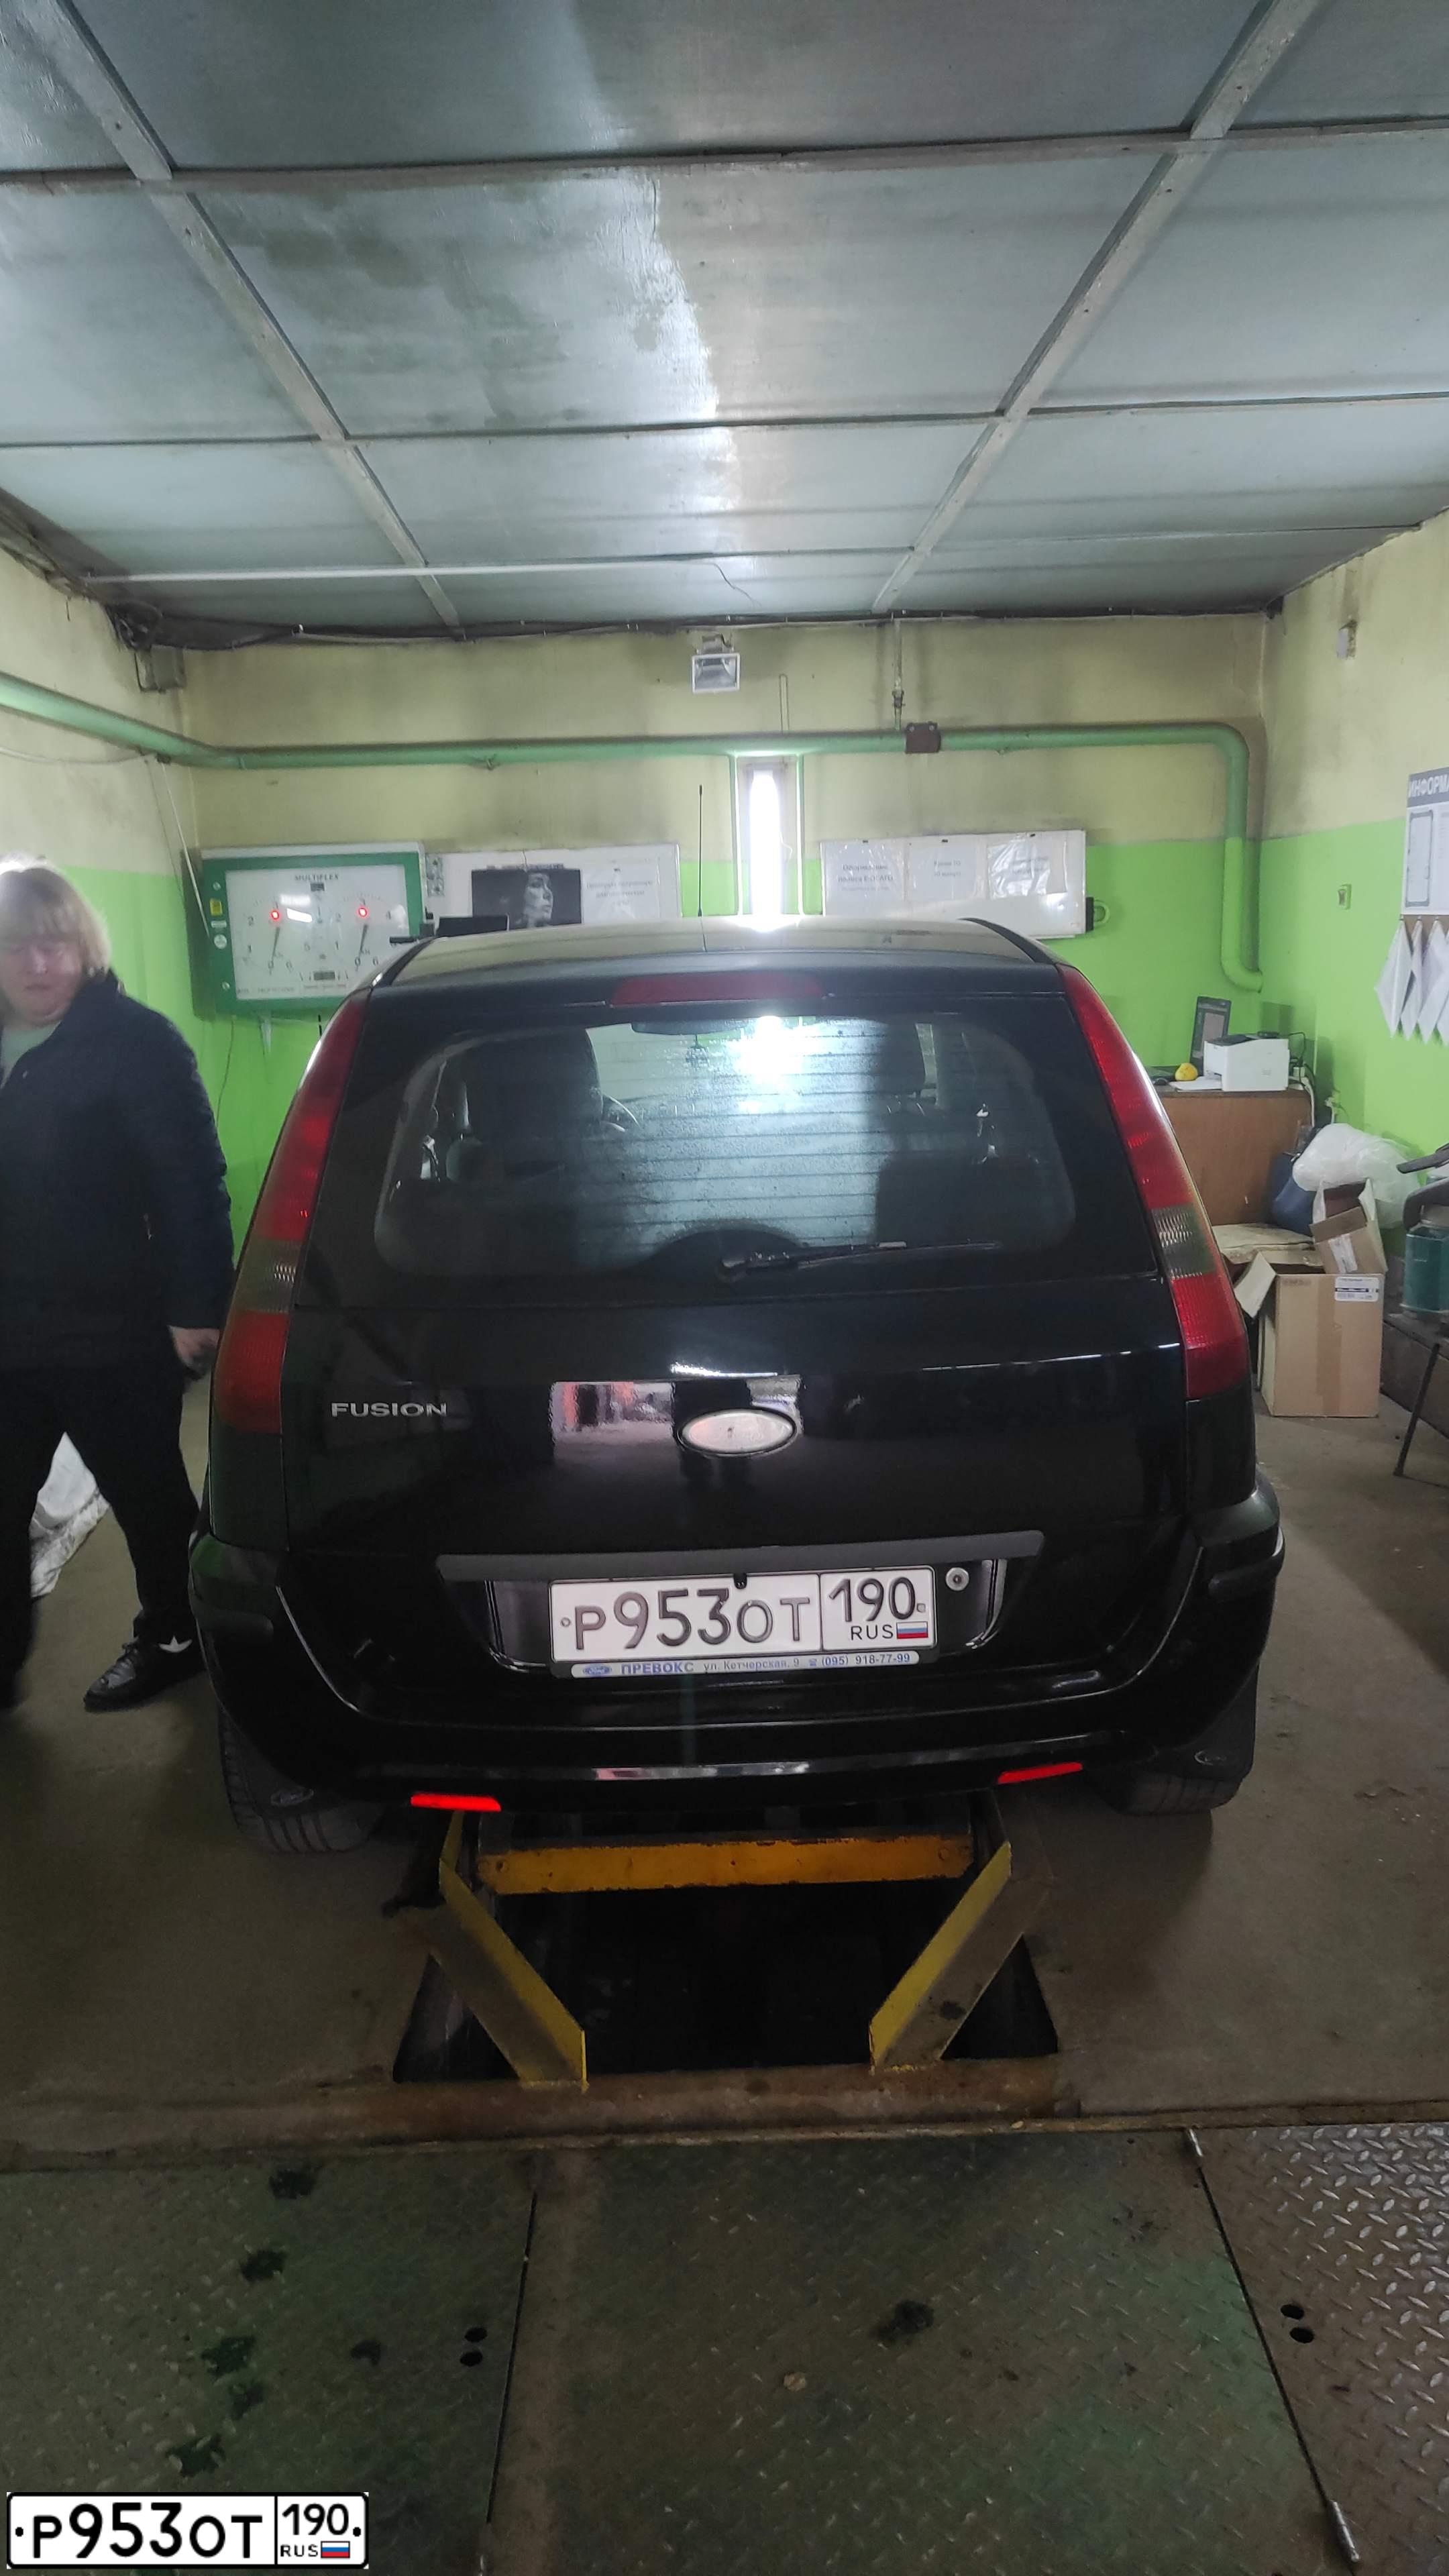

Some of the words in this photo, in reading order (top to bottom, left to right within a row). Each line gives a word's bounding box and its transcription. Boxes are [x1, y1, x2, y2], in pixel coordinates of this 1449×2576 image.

[1409, 774, 1449, 798] ИНФОРМ
[331, 1402, 447, 1417] FUSION
[574, 1588, 810, 1650] Р953ОТ
[828, 1576, 916, 1622] 190
[850, 1623, 894, 1641] RUS
[621, 1662, 694, 1675] ПРЕВОКС
[793, 1658, 800, 1667] 9
[821, 1656, 849, 1666] (095)
[855, 1652, 911, 1664] 918-77-99
